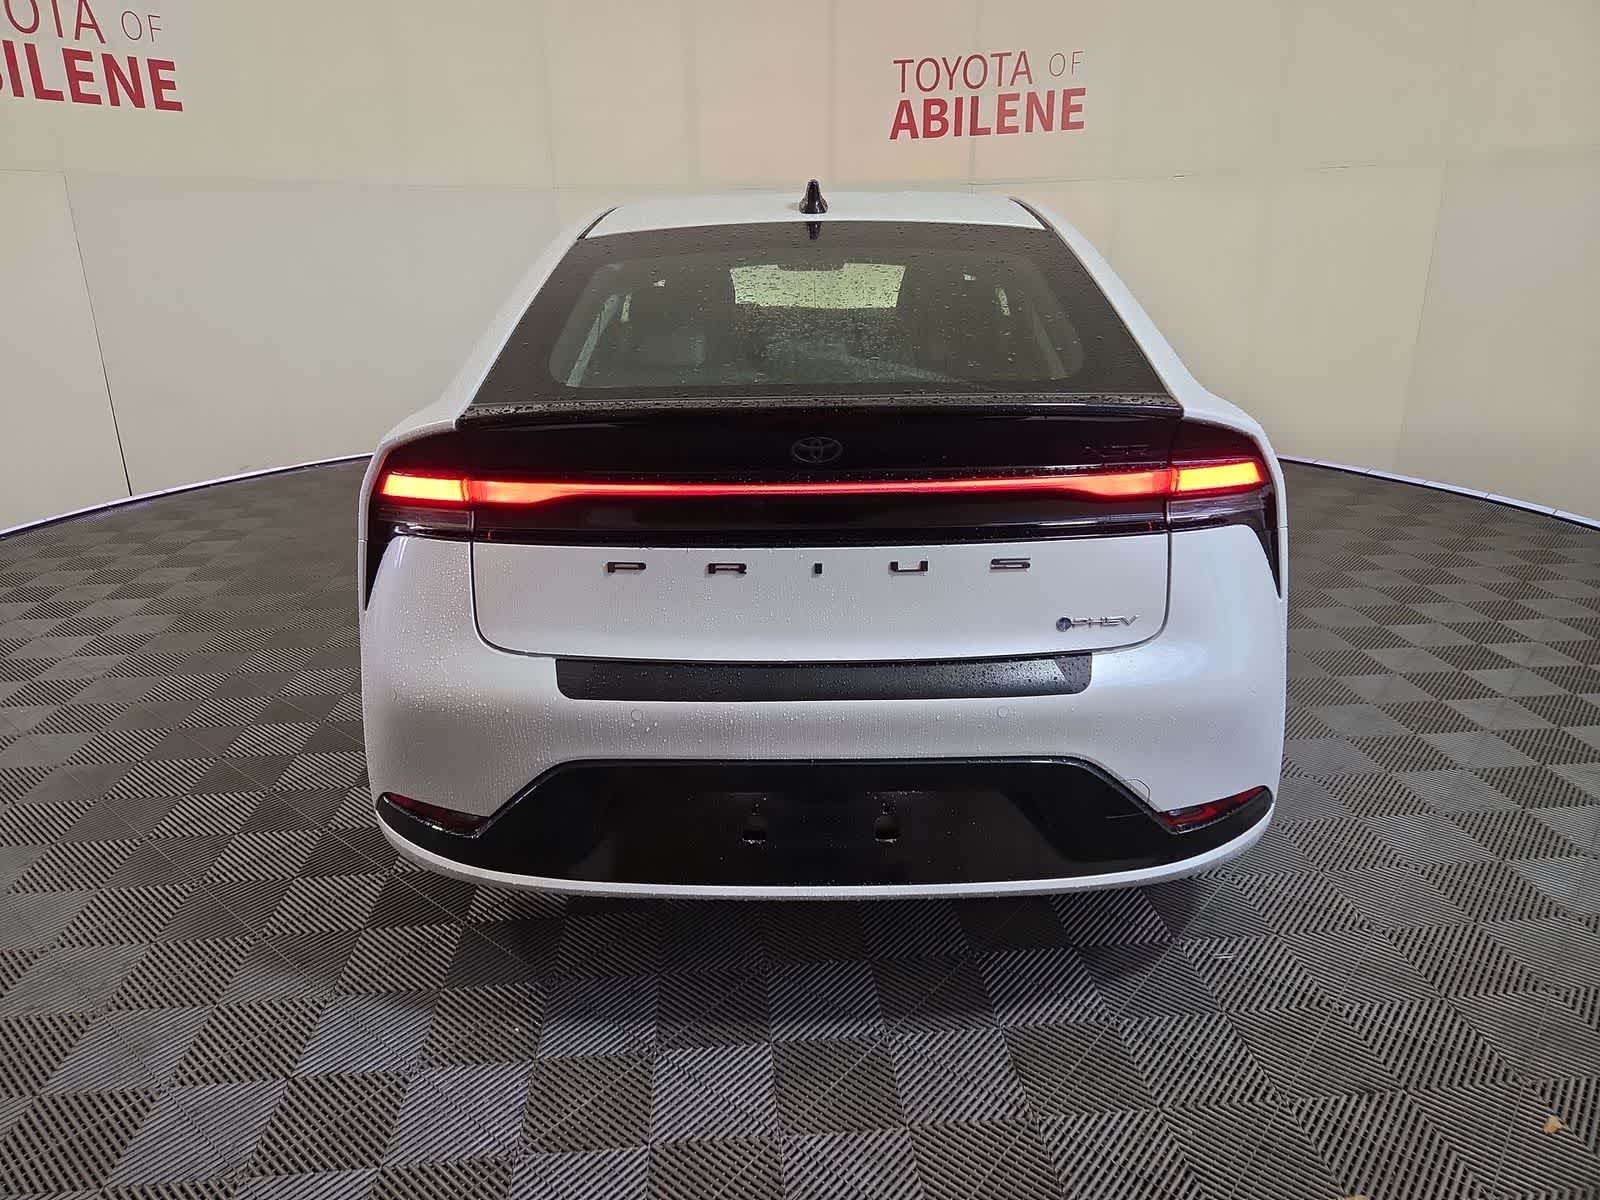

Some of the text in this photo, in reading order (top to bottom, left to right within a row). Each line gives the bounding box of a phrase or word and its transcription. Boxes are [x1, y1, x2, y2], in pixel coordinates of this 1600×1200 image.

[121, 11, 161, 42] OF
[0, 39, 183, 112] ILENE
[893, 50, 1084, 93] TOYOTA OF
[889, 87, 1087, 140] ABILENE
[606, 557, 1031, 576] PRIUS
